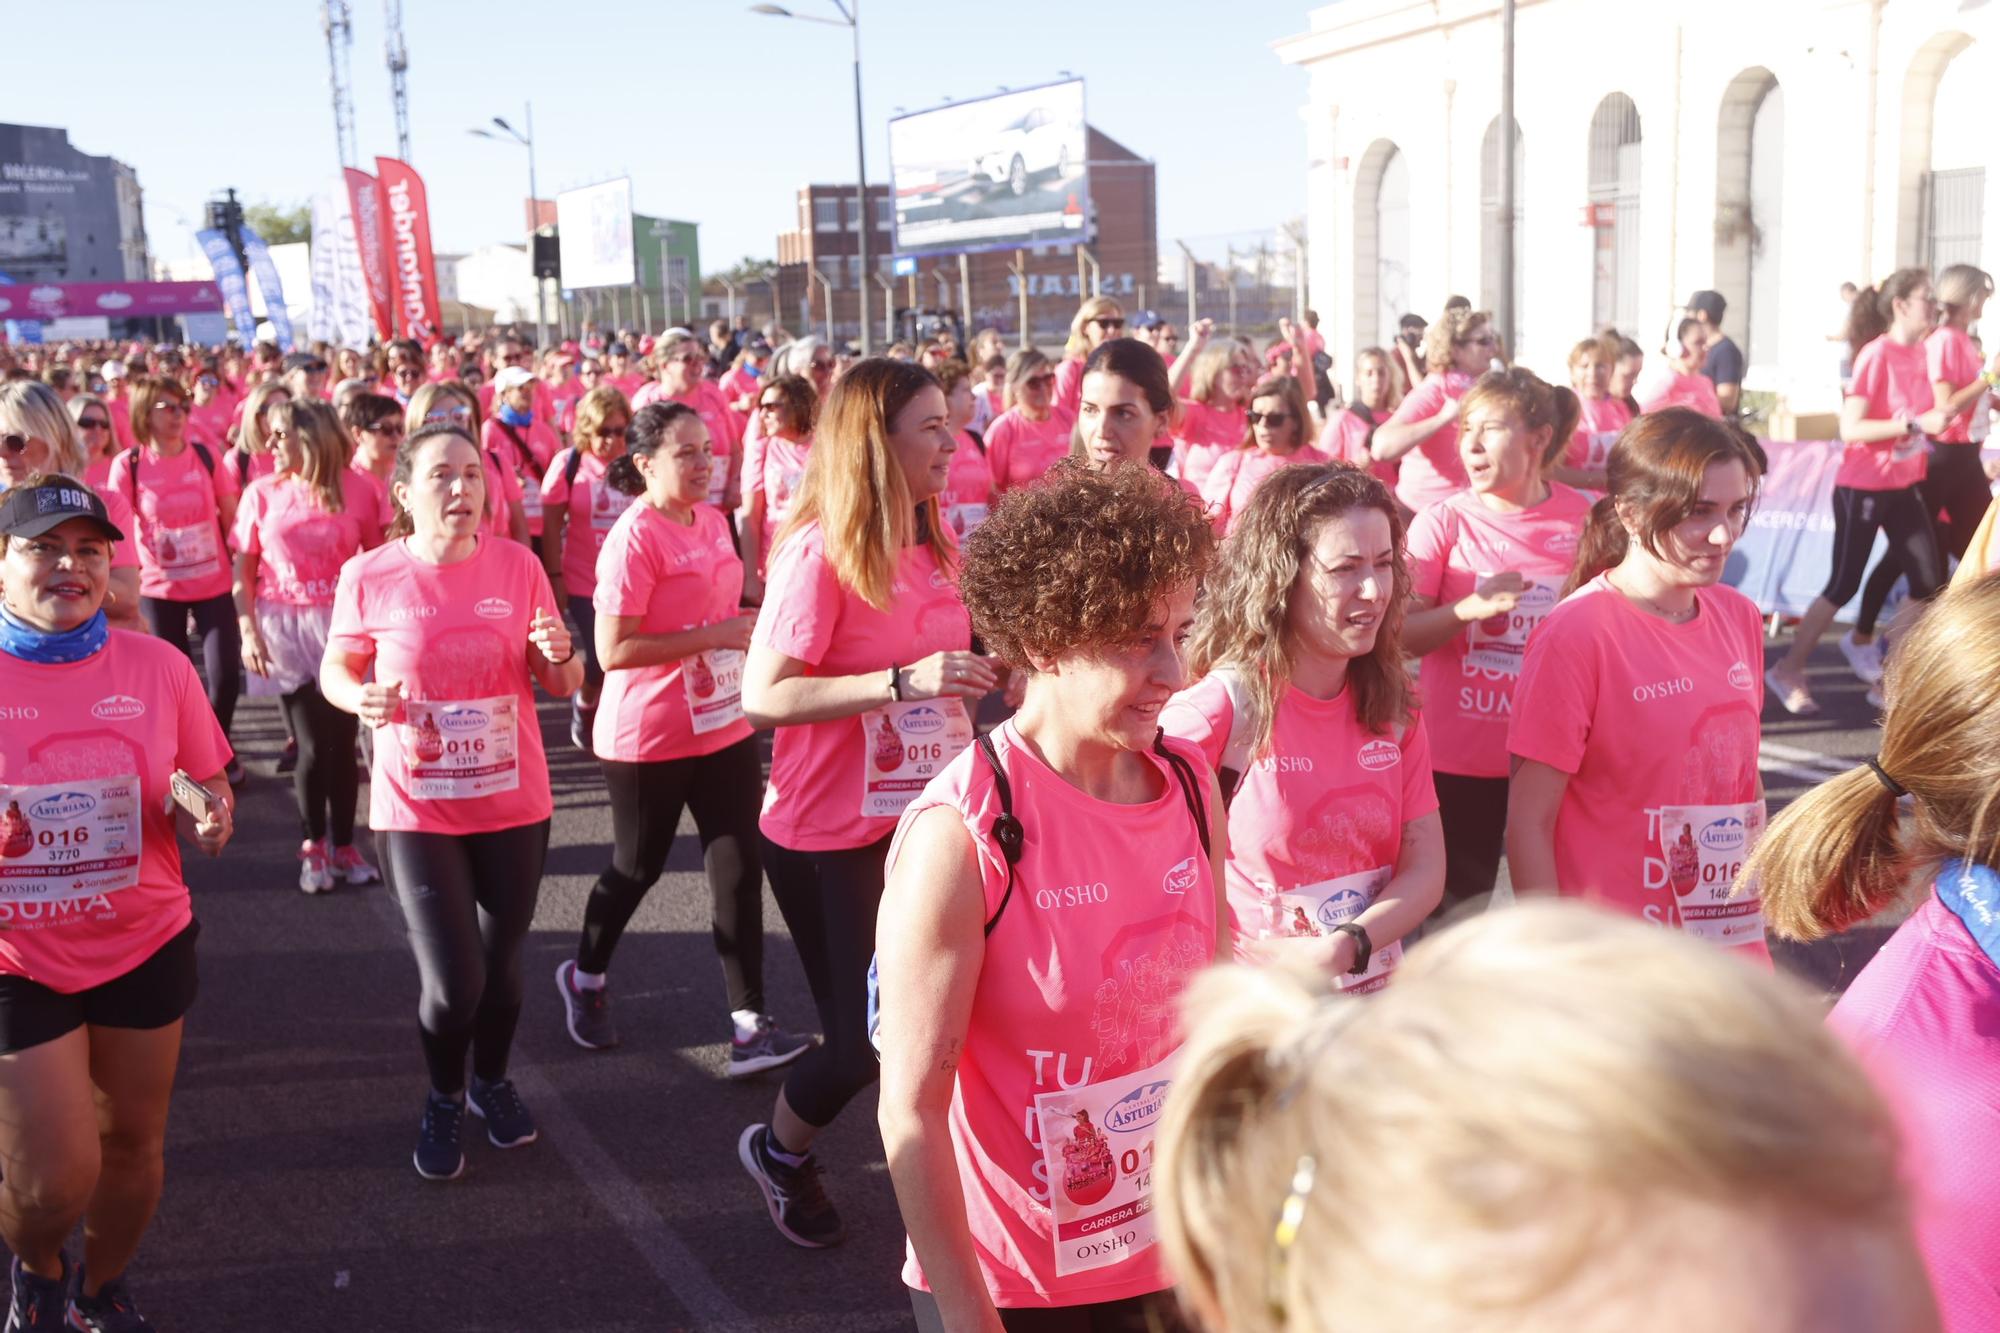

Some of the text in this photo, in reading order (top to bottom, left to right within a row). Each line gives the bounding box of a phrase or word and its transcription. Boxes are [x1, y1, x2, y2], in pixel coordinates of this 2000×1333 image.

[717, 668, 739, 687] 016
[1632, 677, 1694, 702] OYSHO
[446, 739, 485, 754] 016
[908, 743, 942, 761] 016
[916, 764, 933, 774] 430
[34, 801, 92, 817] ASTURIANA
[38, 826, 89, 847] 016
[49, 848, 80, 861] 3770
[3, 867, 46, 877] CARRERA
[47, 866, 61, 875] DE
[62, 865, 74, 875] LA
[75, 862, 105, 873] MUJER
[0, 883, 48, 894] OYSHO
[1036, 882, 1109, 910] OYSHO
[1026, 1049, 1093, 1091] TU
[1081, 1199, 1150, 1233] CARRERA DE
[1076, 1230, 1137, 1260] OYSHO
